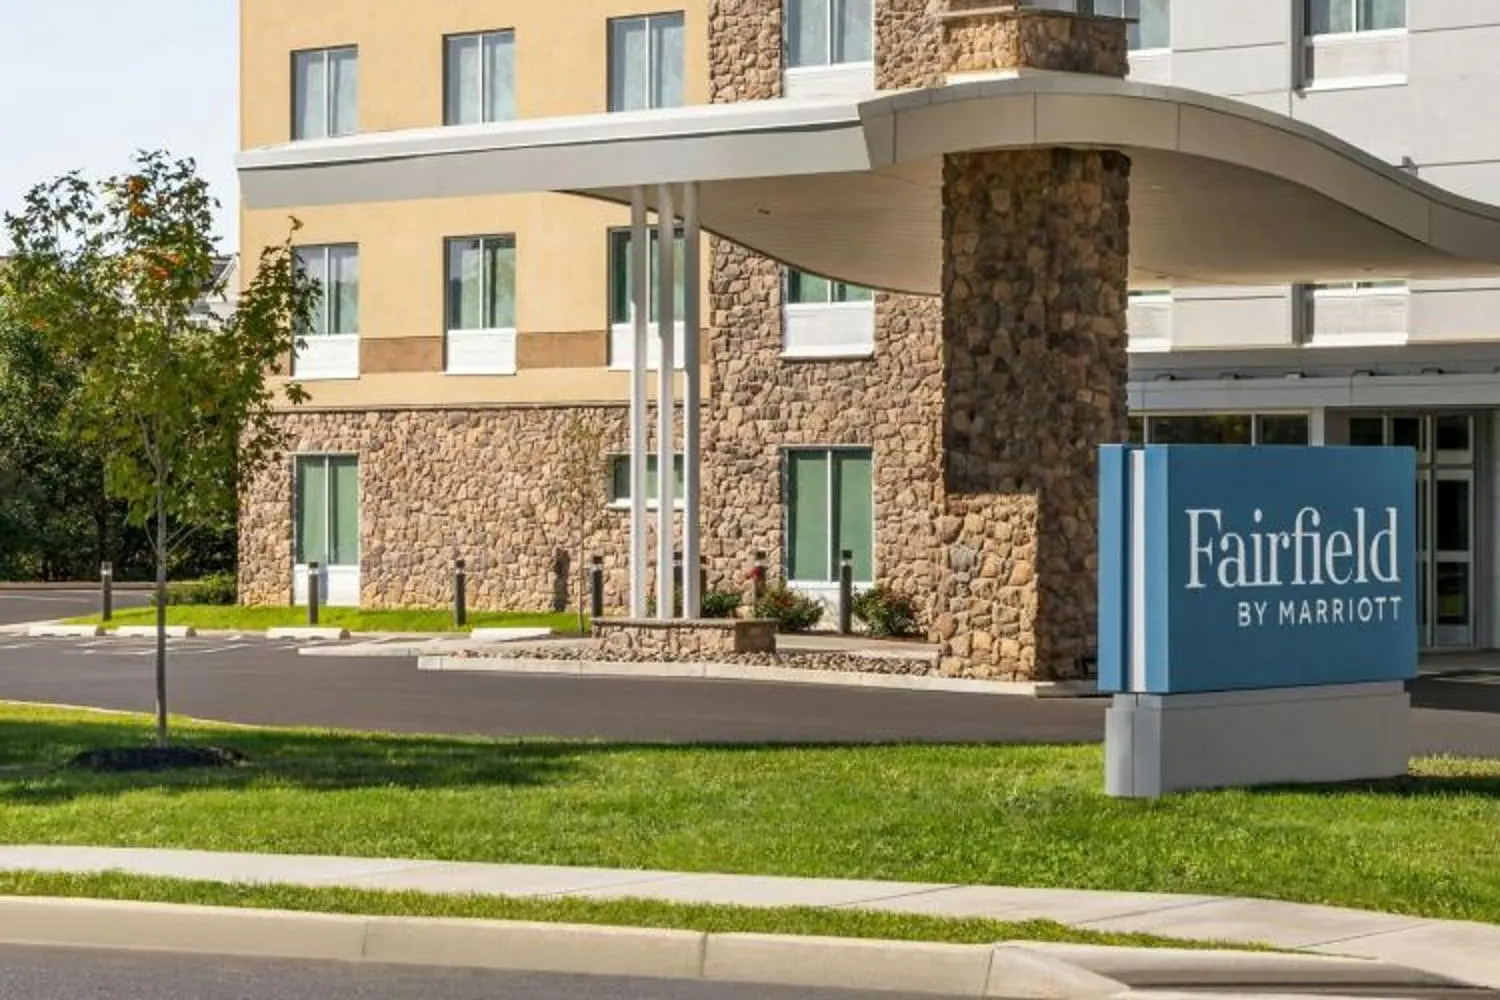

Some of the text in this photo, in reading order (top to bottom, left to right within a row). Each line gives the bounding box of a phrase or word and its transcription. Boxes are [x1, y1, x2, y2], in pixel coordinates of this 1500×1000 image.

[1184, 506, 1401, 589] Fairfield
[1237, 597, 1402, 627] BY MARRIOTT
